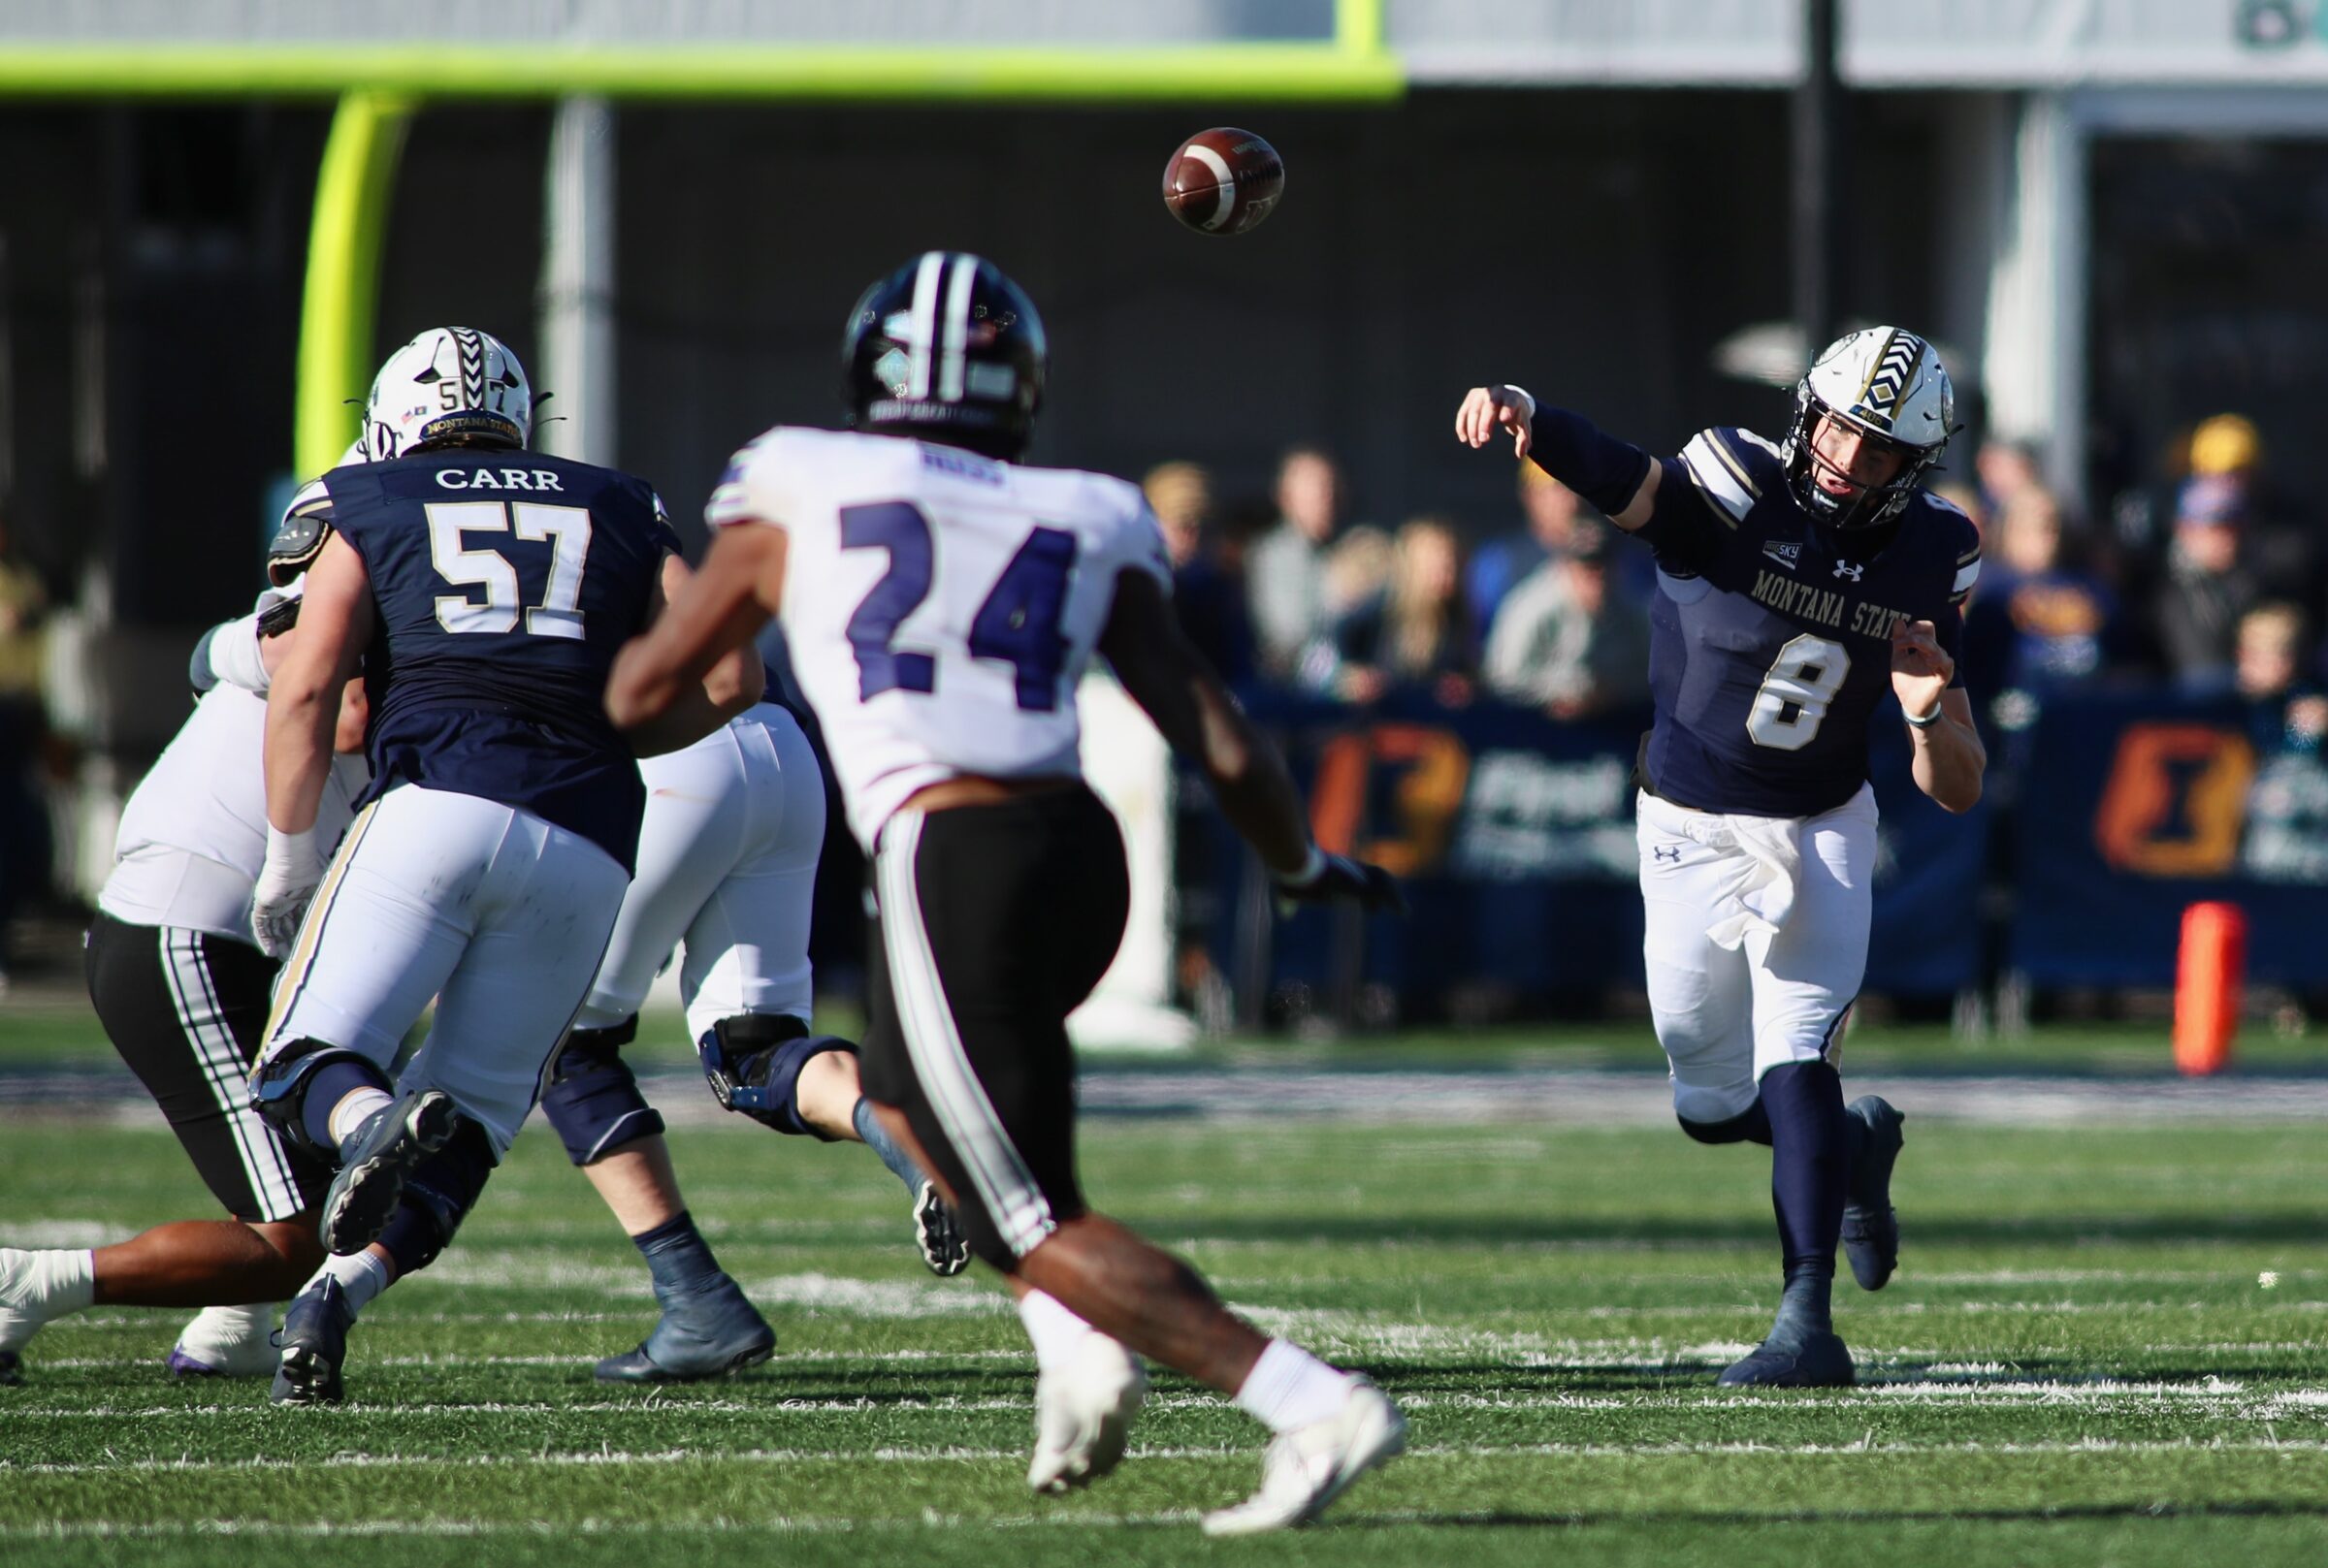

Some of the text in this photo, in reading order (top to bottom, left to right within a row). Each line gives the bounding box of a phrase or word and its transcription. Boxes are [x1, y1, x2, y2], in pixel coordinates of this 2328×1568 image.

[438, 381, 458, 411] 5
[1859, 408, 1883, 426] 406
[427, 417, 488, 435] MONTANA
[436, 468, 565, 492] CARR
[423, 500, 593, 640] 57
[839, 500, 1076, 712] 24
[1751, 568, 1845, 628] MONTANA
[1746, 632, 1852, 751] 8
